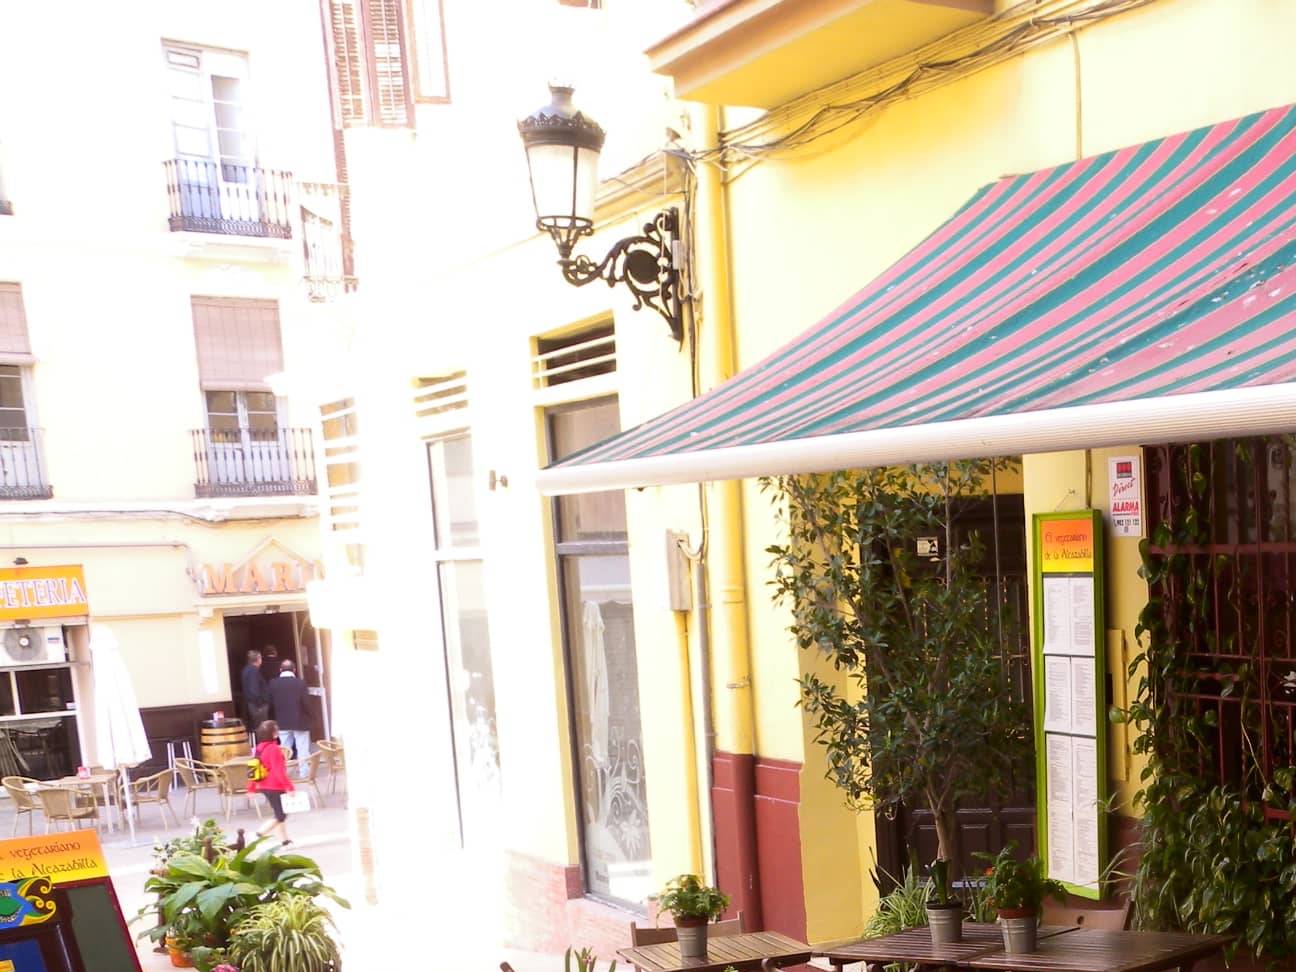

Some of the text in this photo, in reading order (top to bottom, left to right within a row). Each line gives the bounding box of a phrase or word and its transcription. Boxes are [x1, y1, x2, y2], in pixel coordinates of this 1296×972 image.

[1112, 501, 1139, 512] ALARMA
[0, 577, 88, 609] ETERIA
[9, 841, 81, 861] vegetariano
[11, 867, 25, 879] la
[31, 857, 98, 876] Alcazabilla
